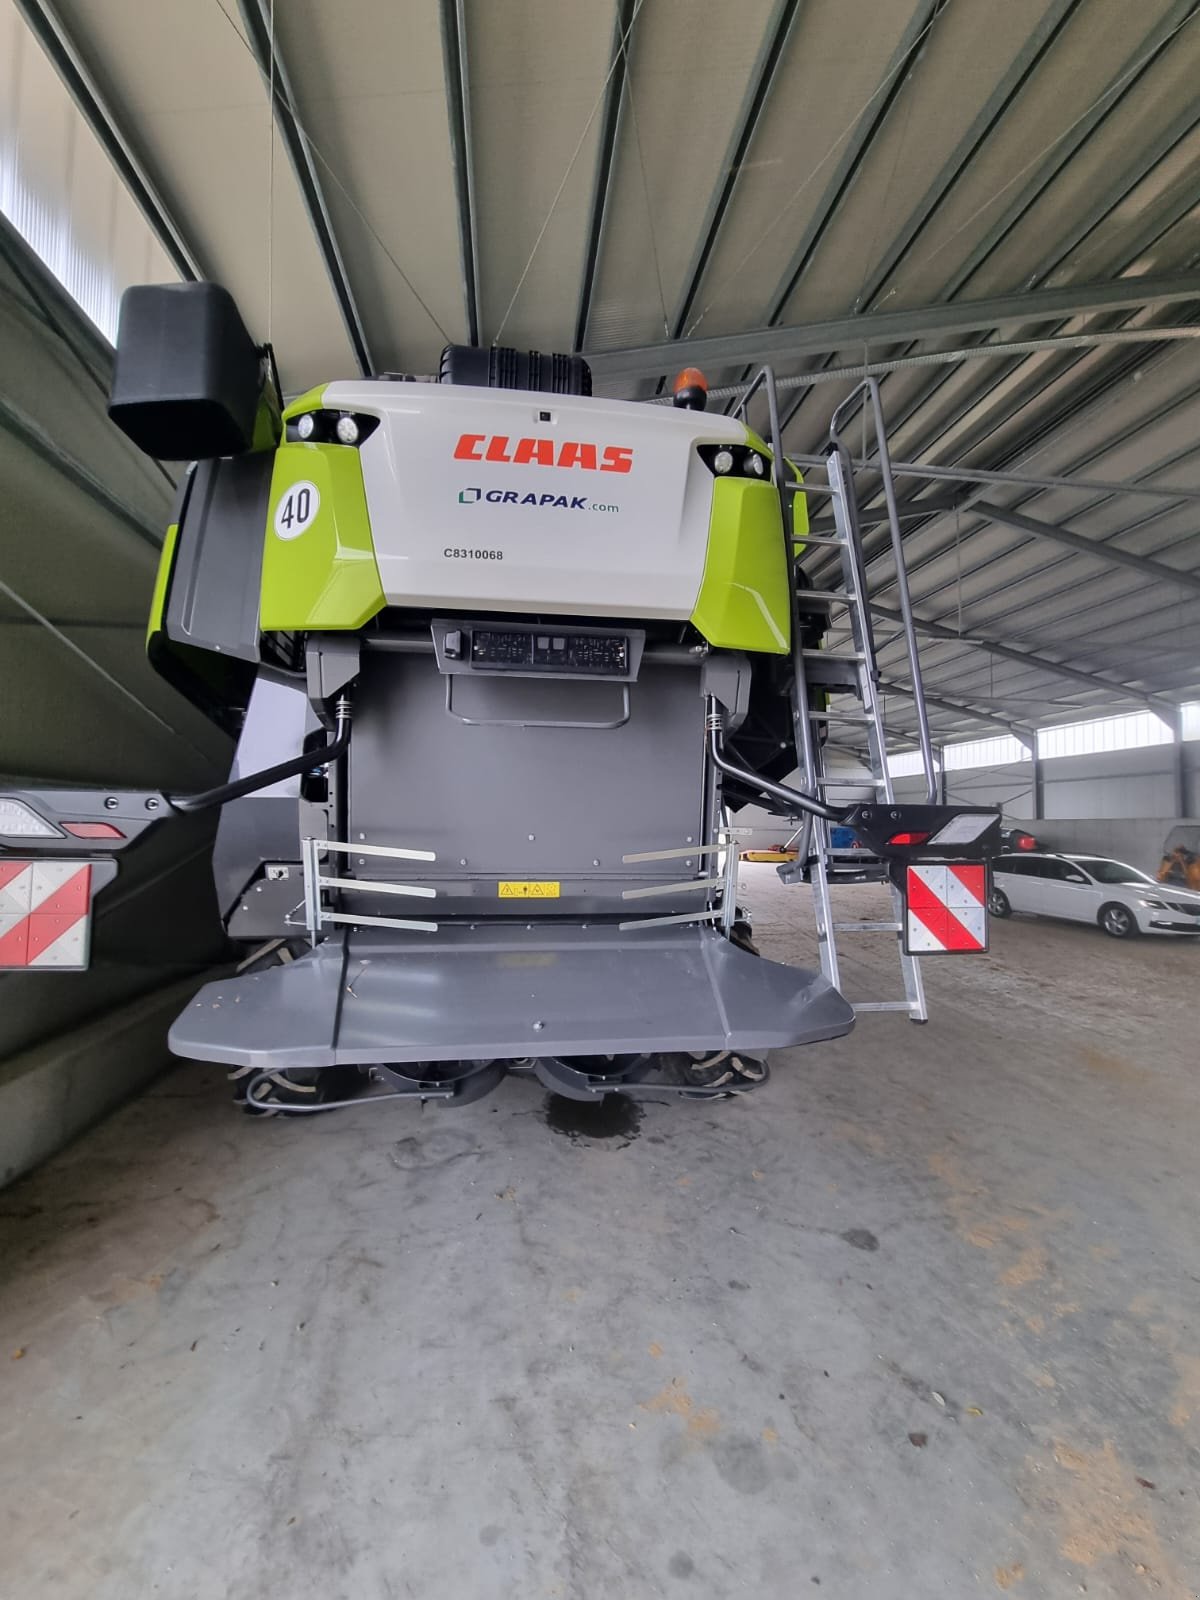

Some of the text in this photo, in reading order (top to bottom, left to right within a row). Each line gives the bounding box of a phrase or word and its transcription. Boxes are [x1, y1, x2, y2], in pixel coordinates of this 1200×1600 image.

[454, 434, 633, 473] CLAAS
[281, 488, 310, 528] 40
[444, 548, 503, 560] C8310068
